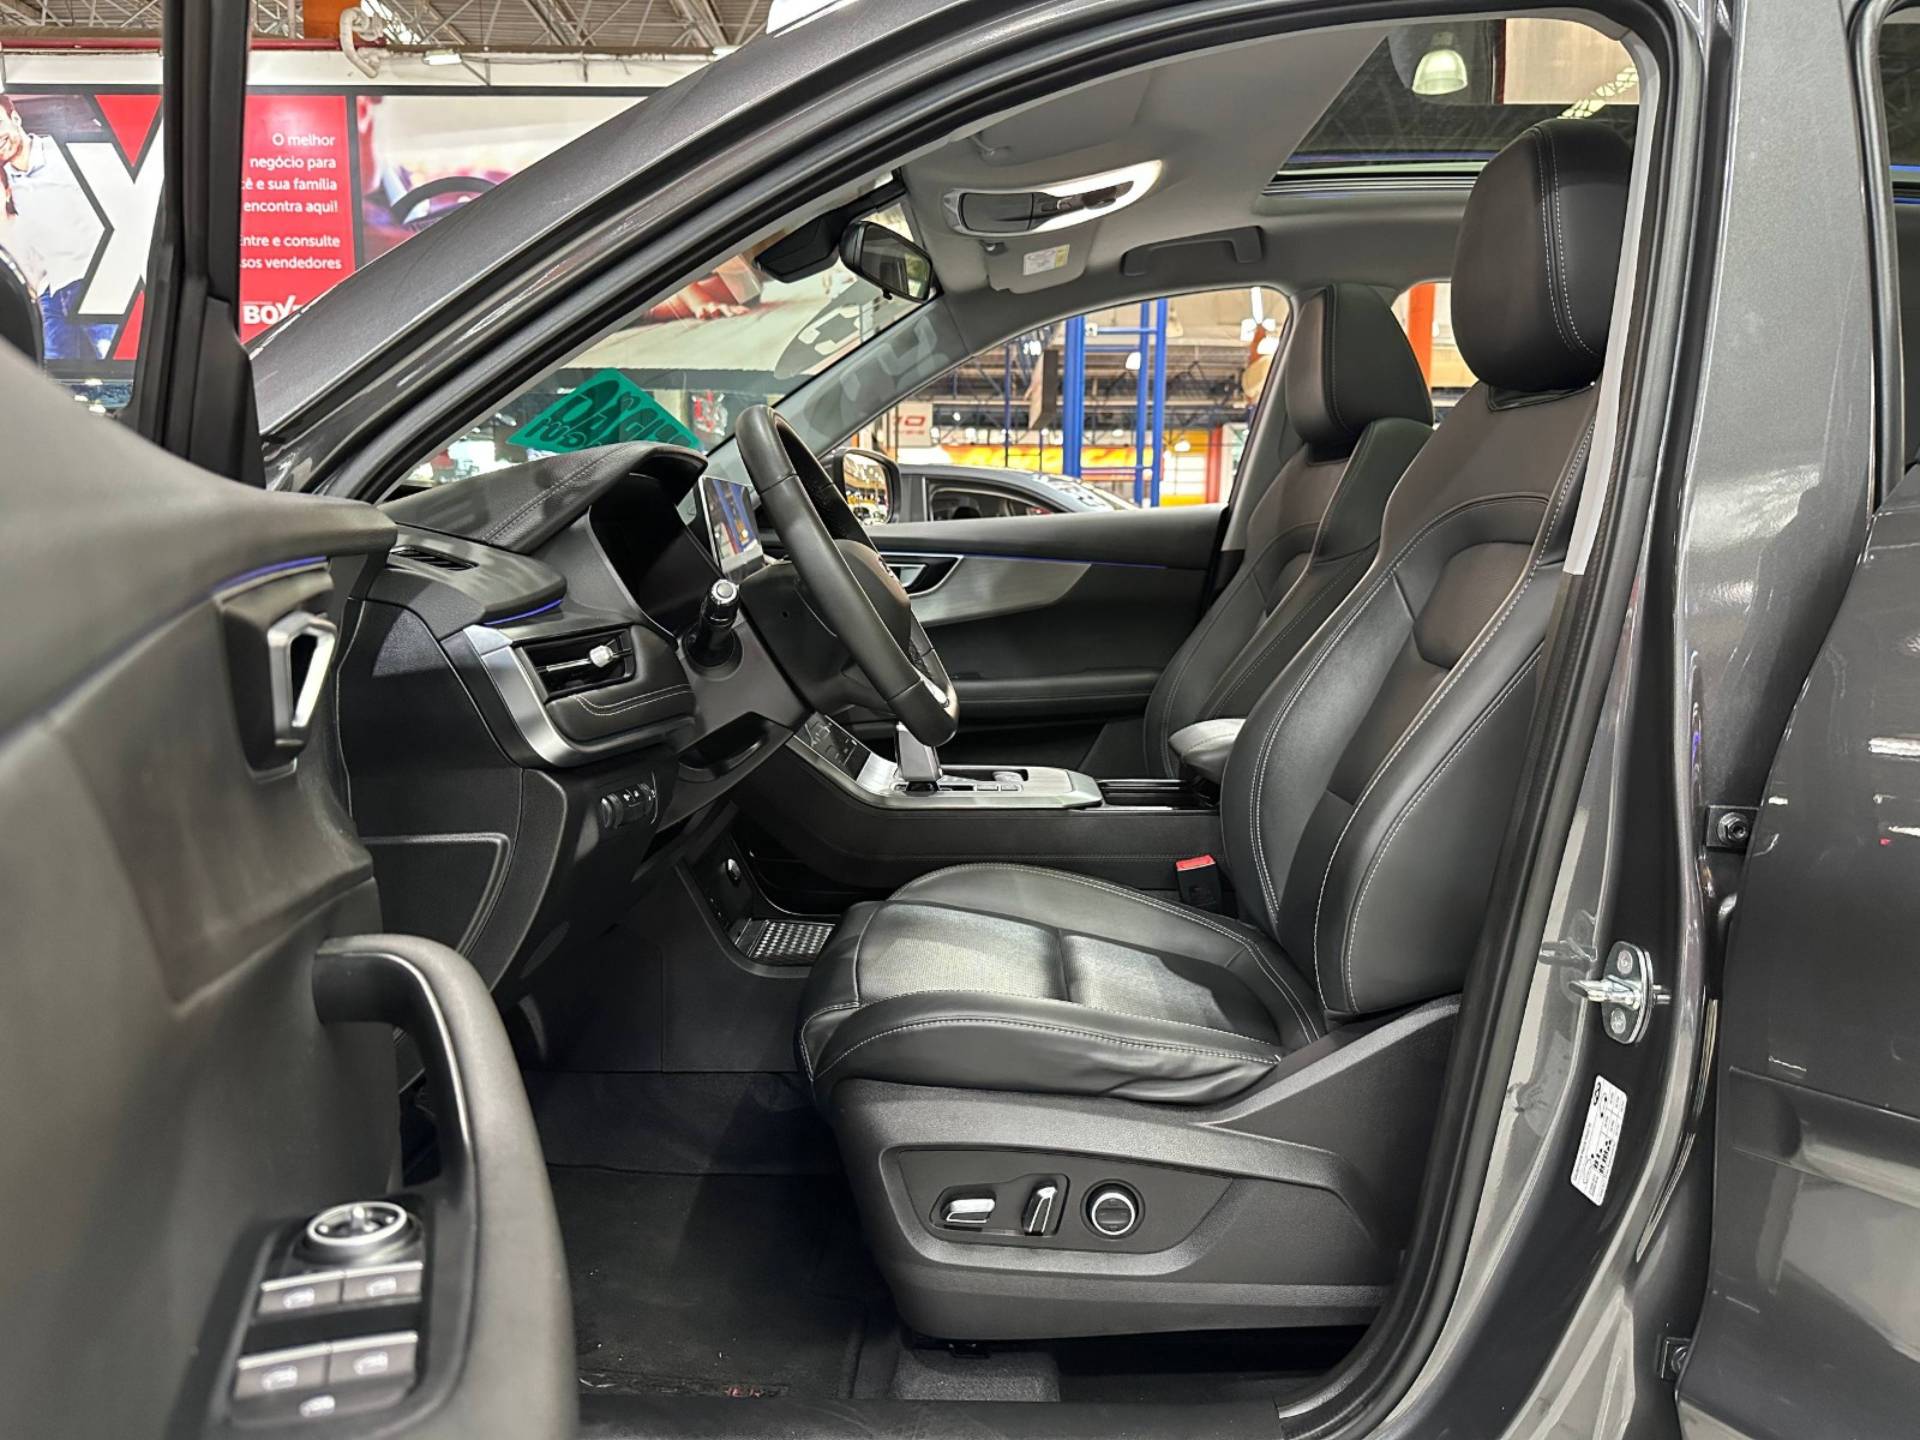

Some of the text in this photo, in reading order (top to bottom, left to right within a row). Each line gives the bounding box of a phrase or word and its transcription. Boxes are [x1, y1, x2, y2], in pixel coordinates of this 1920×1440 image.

[272, 132, 335, 146] O melhor
[250, 155, 336, 171] negócio para
[256, 180, 265, 190] e
[268, 180, 290, 190] sua
[293, 177, 337, 191] família
[243, 200, 338, 215] encontra aqui!
[272, 236, 281, 247] e
[283, 235, 341, 247] consulte
[265, 256, 342, 270] vendedores
